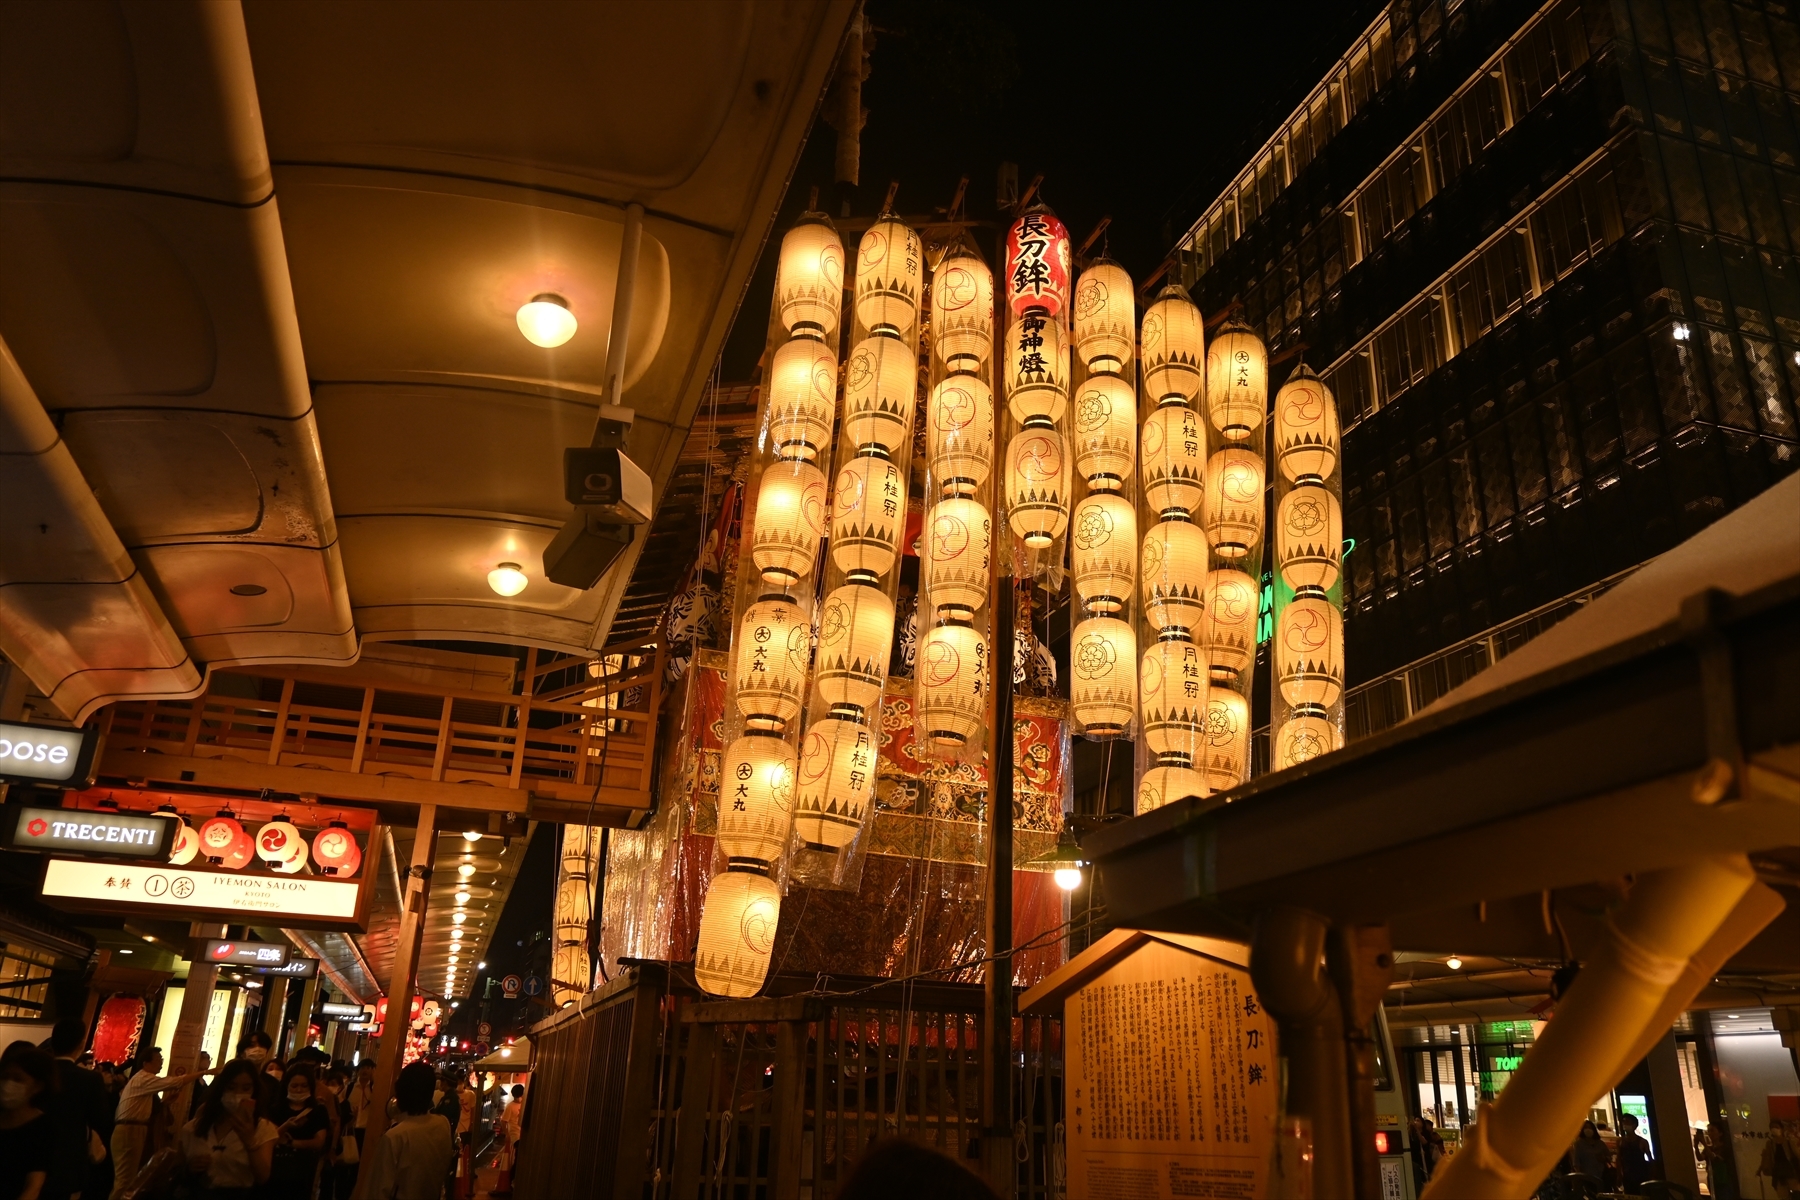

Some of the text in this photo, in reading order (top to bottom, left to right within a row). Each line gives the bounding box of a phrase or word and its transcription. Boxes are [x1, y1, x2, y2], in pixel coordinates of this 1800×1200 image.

[904, 228, 919, 277] 月桂冠
[1012, 214, 1050, 296] 長刀鉾
[1018, 316, 1047, 375] 御神燈
[1237, 366, 1249, 387] 大丸
[1182, 411, 1198, 457] 月桂冠
[883, 463, 900, 519] 月桂冠
[751, 645, 768, 673] 大丸
[973, 660, 985, 697] 大丸
[1182, 646, 1199, 699] 月桂冠
[848, 730, 870, 791] 月桂冠
[732, 783, 748, 812] 大丸
[51, 820, 156, 846] TRECENTI
[213, 876, 307, 892] IYEMON SALON
[1243, 994, 1263, 1086] 長刀鉾
